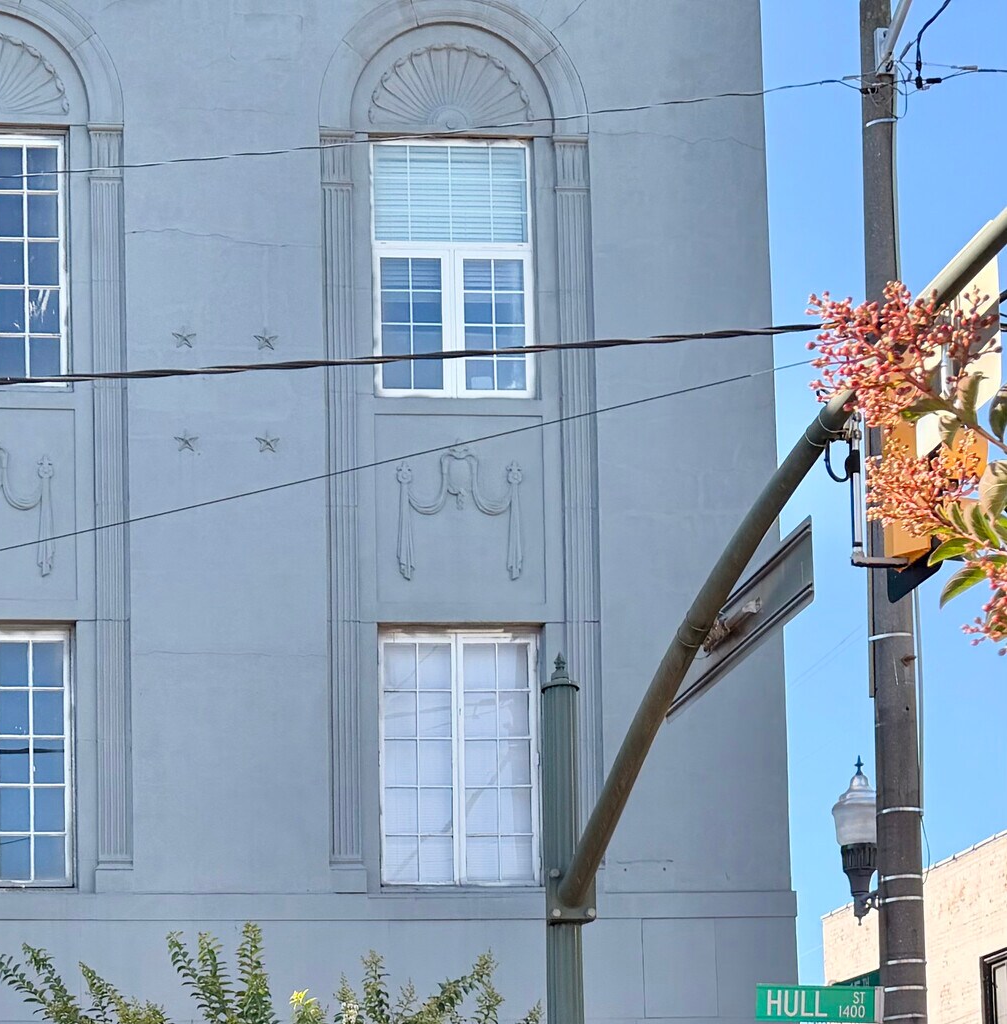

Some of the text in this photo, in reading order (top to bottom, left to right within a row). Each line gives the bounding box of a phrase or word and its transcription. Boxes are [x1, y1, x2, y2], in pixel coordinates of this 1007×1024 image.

[766, 989, 828, 1017] HULL
[852, 991, 866, 1004] ST
[839, 1005, 866, 1018] 1400
